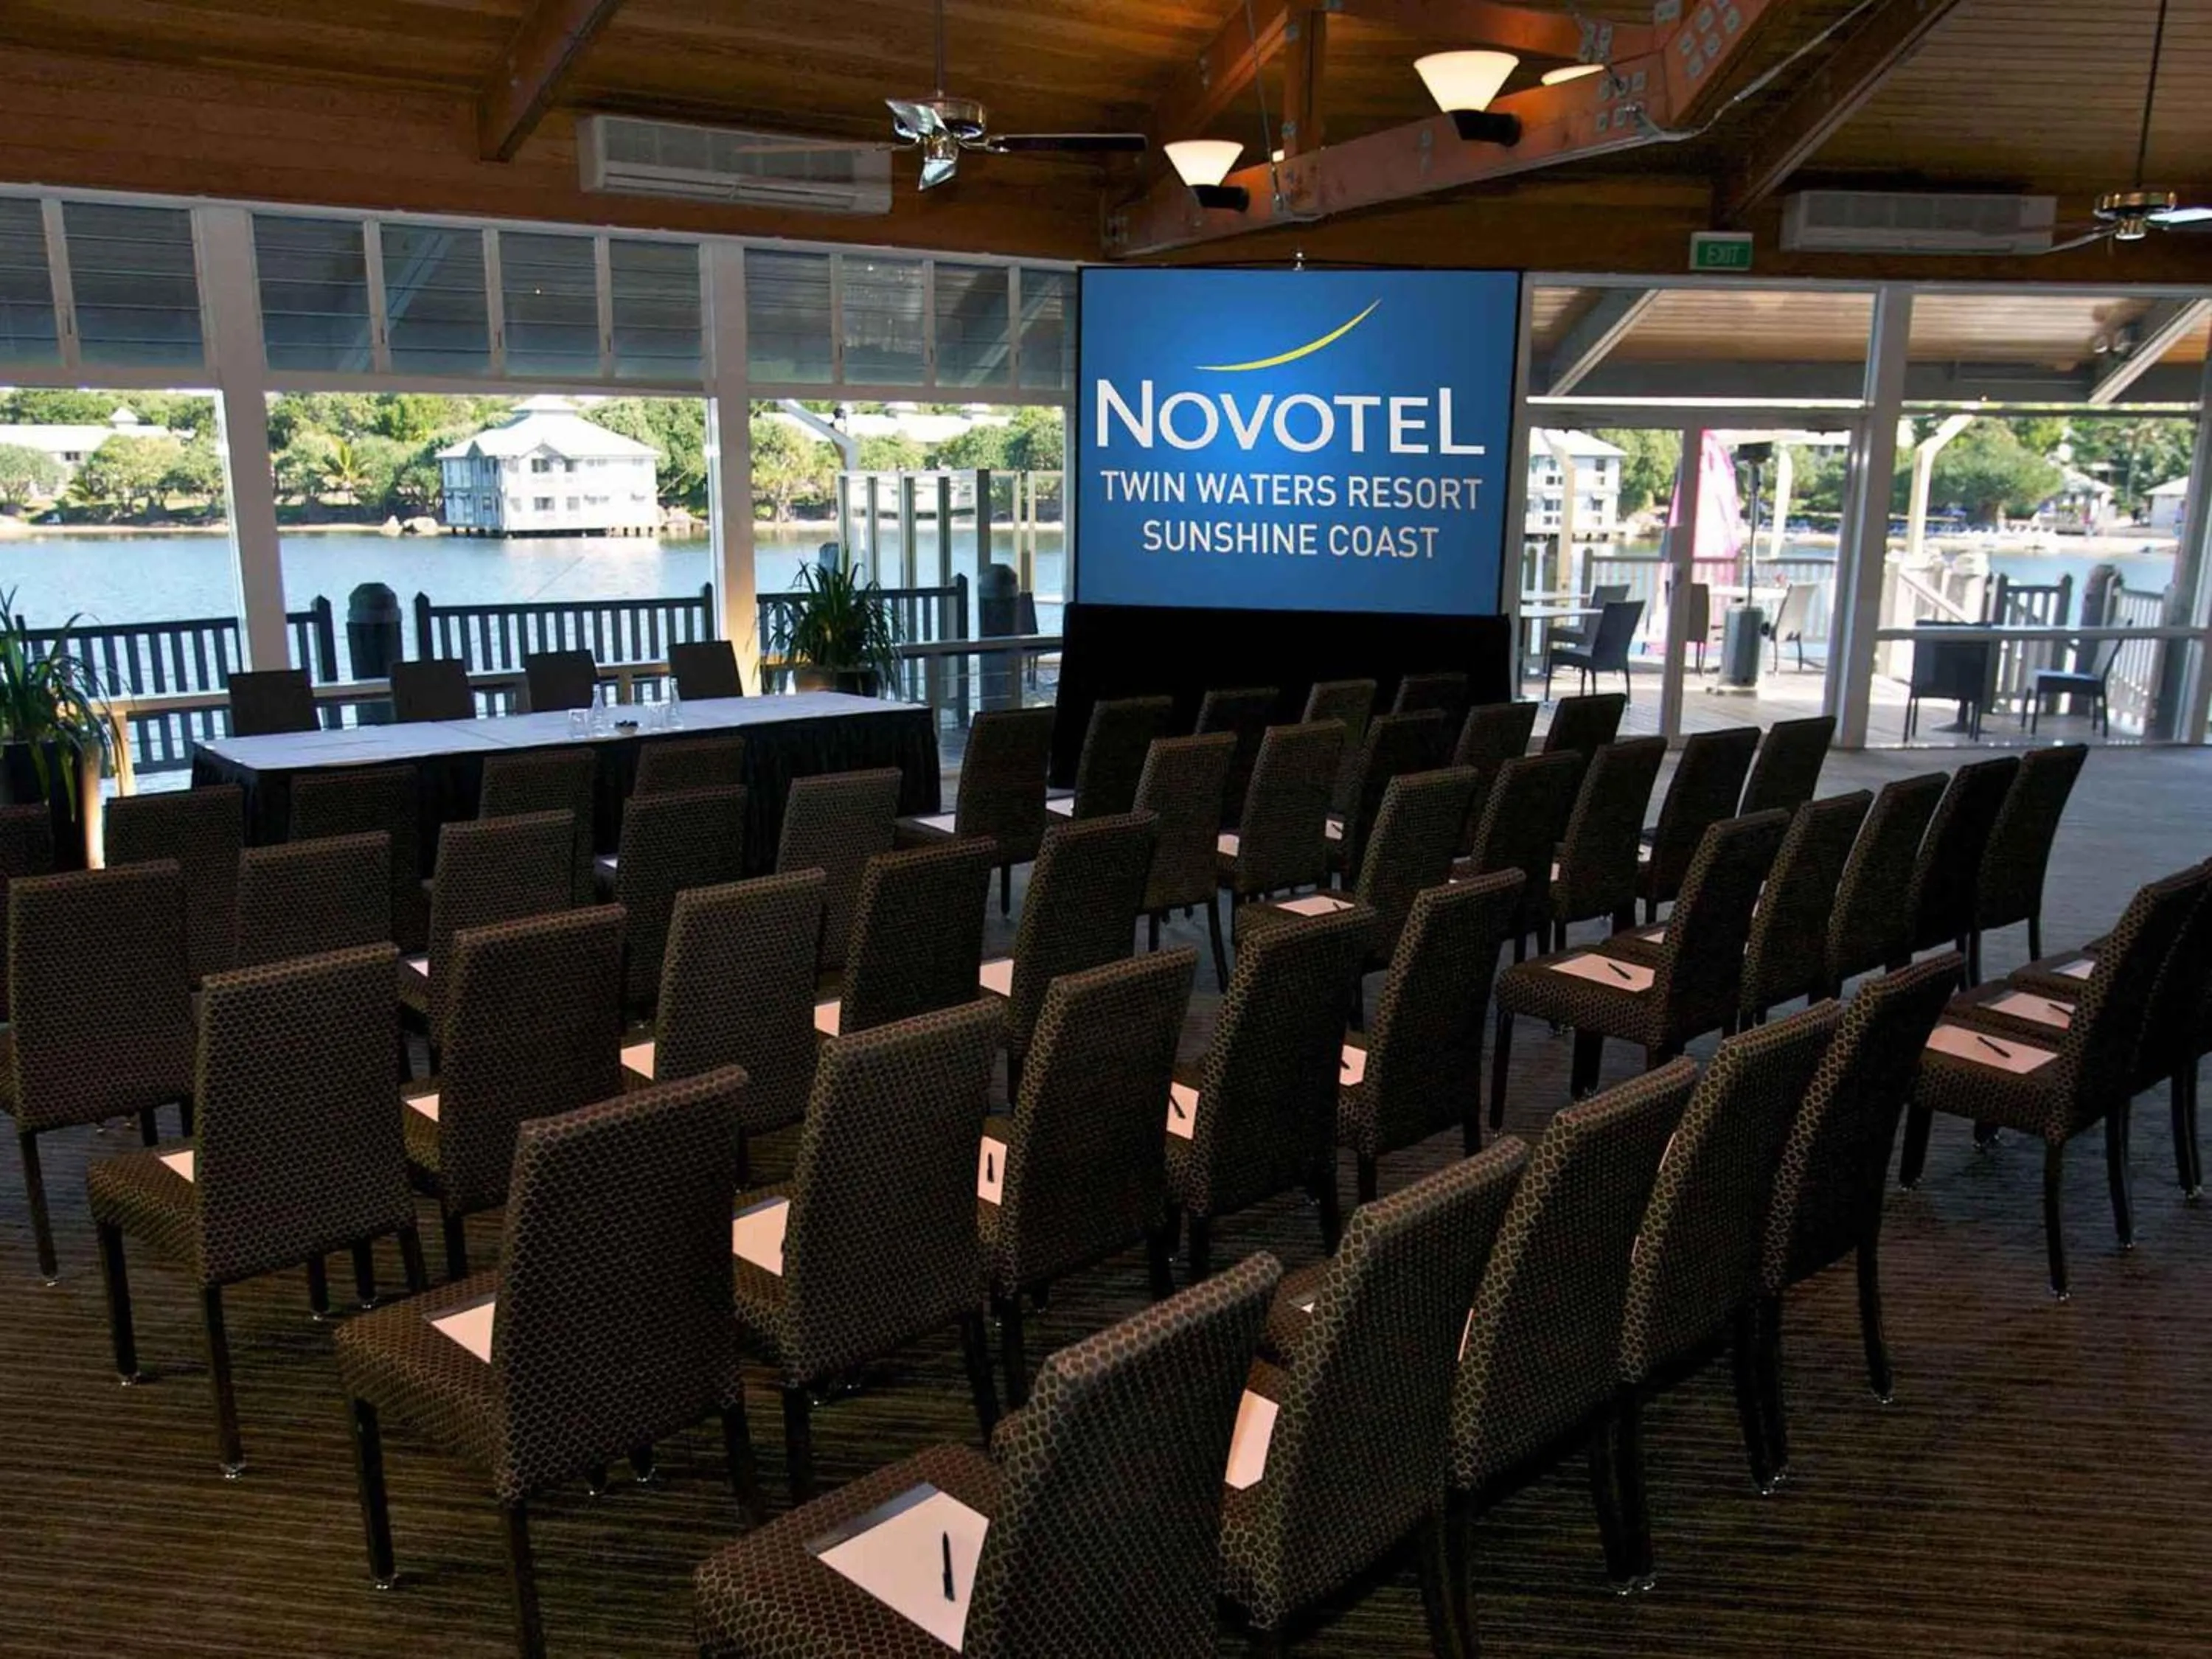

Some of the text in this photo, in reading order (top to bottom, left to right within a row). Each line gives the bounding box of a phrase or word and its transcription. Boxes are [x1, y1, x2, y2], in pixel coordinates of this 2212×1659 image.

[1707, 245, 1741, 264] EXIT
[1097, 380, 1485, 454] NOVOTEL
[1100, 470, 1482, 509] TWIN WATERS RESORT
[1144, 520, 1439, 557] SUNSHINE COAST
